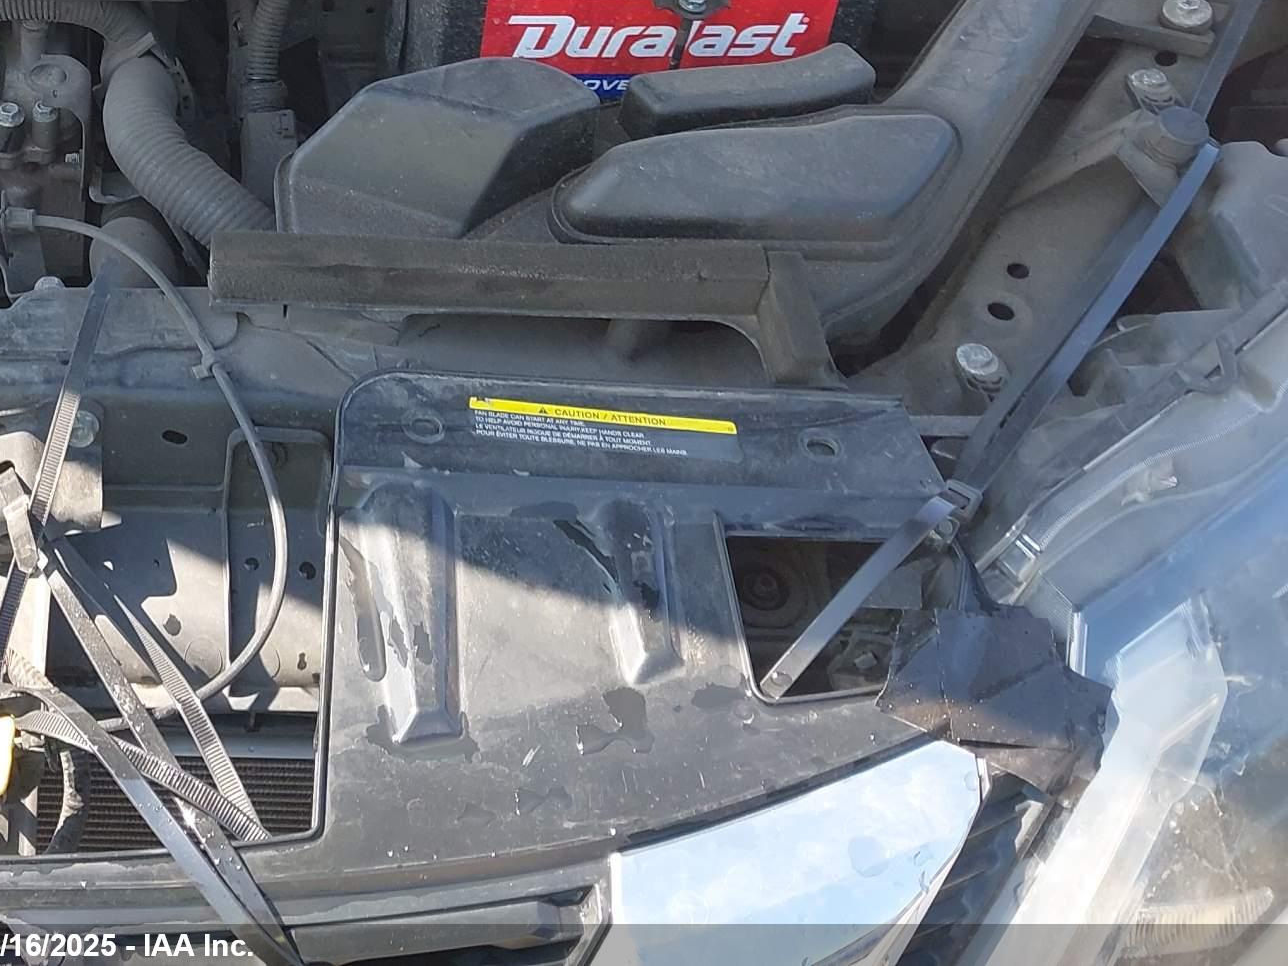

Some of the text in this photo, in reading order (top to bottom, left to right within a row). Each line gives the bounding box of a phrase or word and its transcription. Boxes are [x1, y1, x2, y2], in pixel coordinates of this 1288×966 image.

[508, 12, 806, 59] Duralast
[578, 78, 631, 91] OVE
[554, 408, 600, 420] CAUTION
[611, 414, 666, 426] ATTENTION
